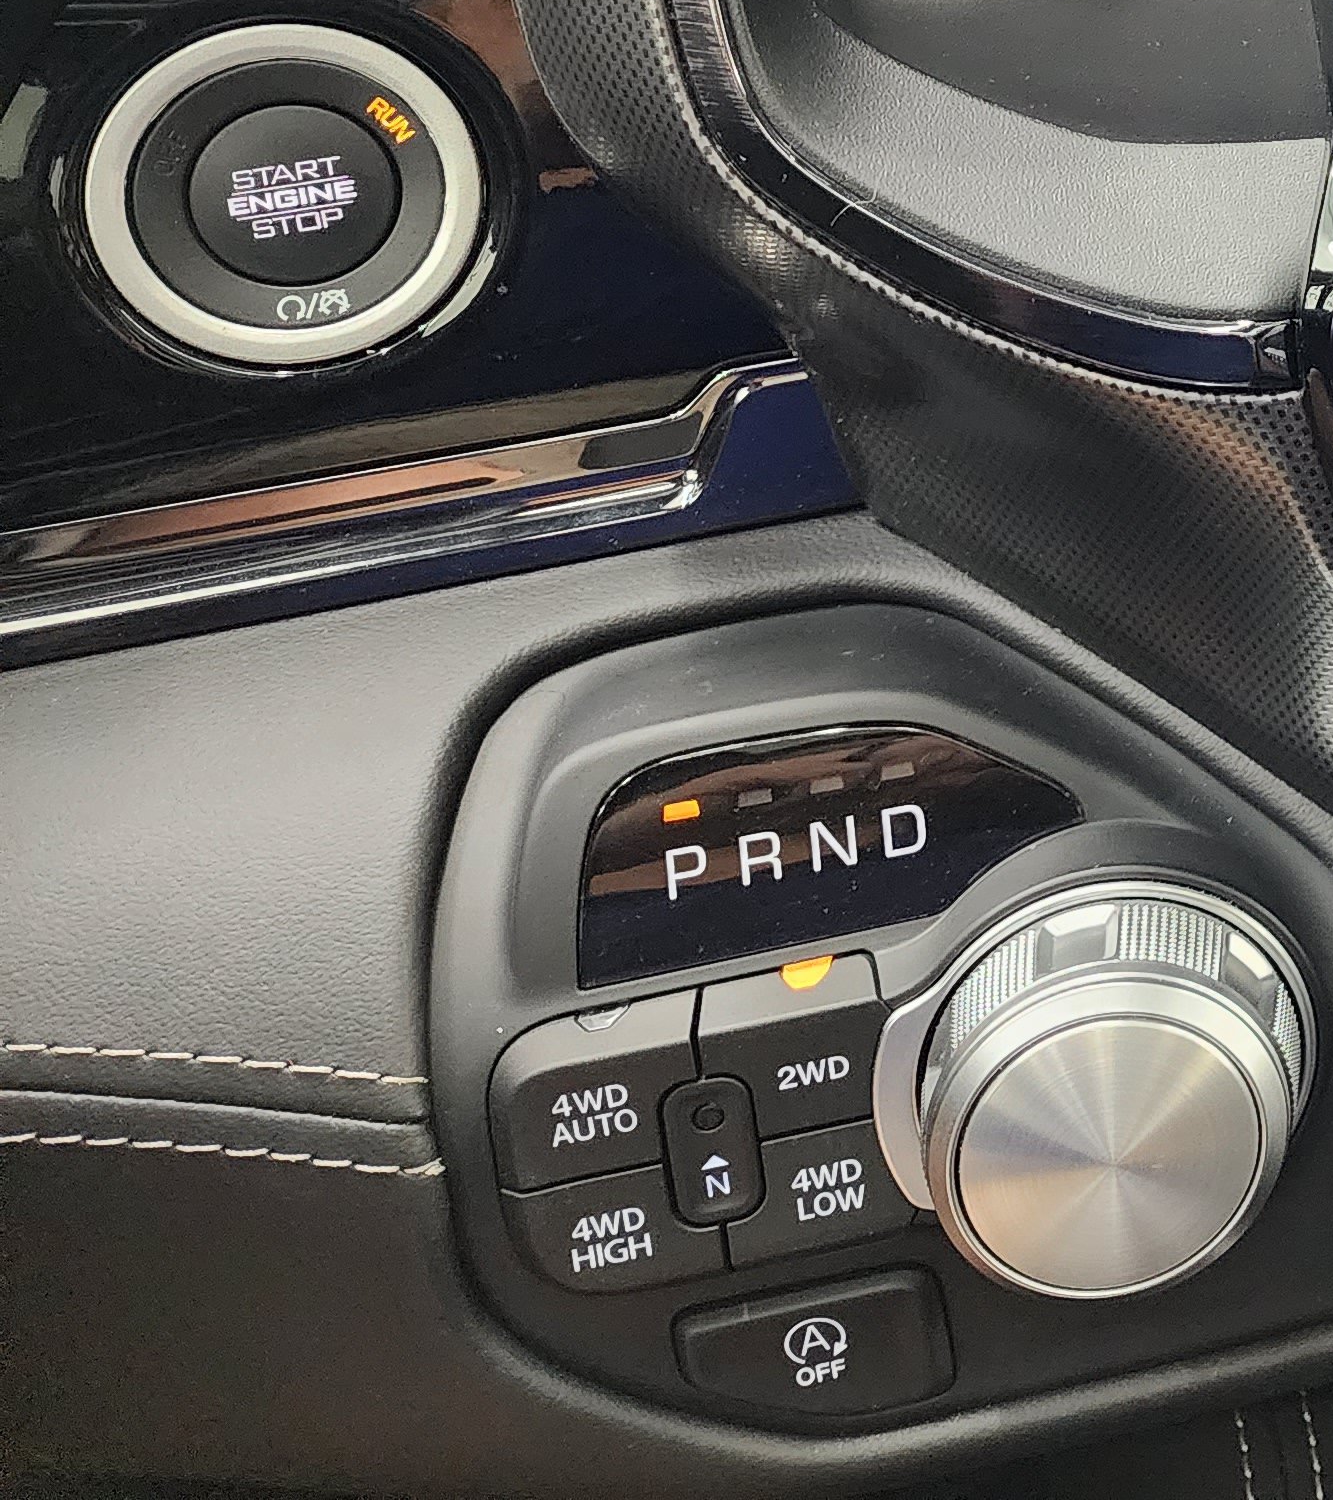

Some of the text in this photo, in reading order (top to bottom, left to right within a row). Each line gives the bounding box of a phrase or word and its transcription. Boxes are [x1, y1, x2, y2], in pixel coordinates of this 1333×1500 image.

[366, 95, 418, 146] RUN
[230, 154, 342, 191] START
[225, 177, 358, 219] ENGINE
[252, 205, 345, 240] STOP
[664, 803, 928, 902] P R N D
[777, 1054, 850, 1091] 2WD
[551, 1083, 629, 1118] 4WD
[552, 1108, 639, 1148] AUTO
[704, 1171, 731, 1198] N
[791, 1158, 863, 1192] 4WD
[796, 1184, 865, 1222] LOW
[571, 1207, 646, 1242] 4WD
[571, 1232, 654, 1273] HIGH
[795, 1357, 846, 1387] OFF
